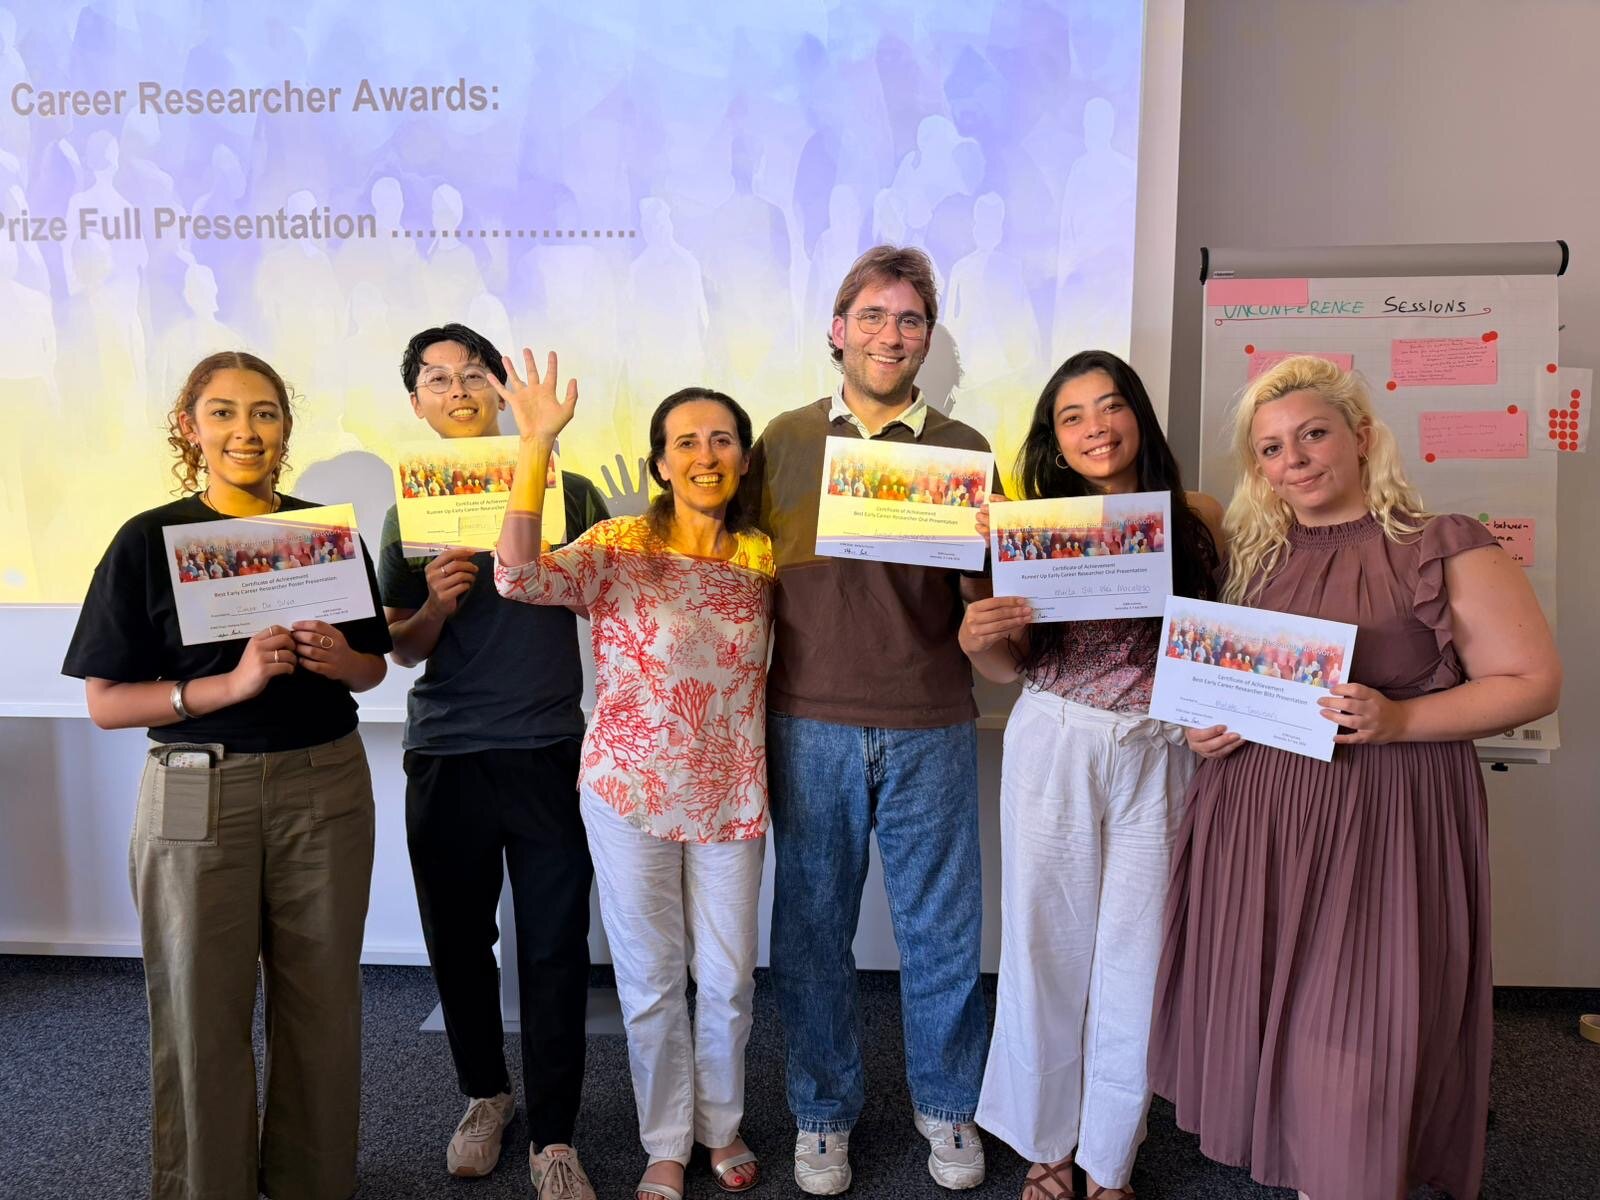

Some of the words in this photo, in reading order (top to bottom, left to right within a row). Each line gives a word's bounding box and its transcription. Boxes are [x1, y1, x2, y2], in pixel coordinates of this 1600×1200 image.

[11, 82, 126, 117] Career
[138, 79, 342, 115] Researcher
[352, 77, 500, 112] Awards:
[0, 209, 67, 242] rize
[78, 207, 141, 240] Full
[153, 205, 377, 240] Presentation
[876, 505, 900, 513] Certificate
[906, 508, 936, 517] Achievement
[892, 513, 917, 521] Researcher
[928, 517, 958, 525] Presentation
[225, 589, 240, 597] Early
[258, 582, 287, 591] Researcher
[304, 575, 337, 584] Presentation
[240, 579, 268, 588] Certificate
[274, 573, 309, 583] Achievement
[1191, 675, 1203, 683] Best
[1203, 677, 1217, 686] Early
[1216, 680, 1234, 689] Career
[1234, 684, 1263, 696] Researcher
[1263, 690, 1275, 698] Blitz
[1275, 693, 1308, 705] Presentation
[1216, 673, 1243, 685] Certificate
[1249, 680, 1284, 693] Achievement
